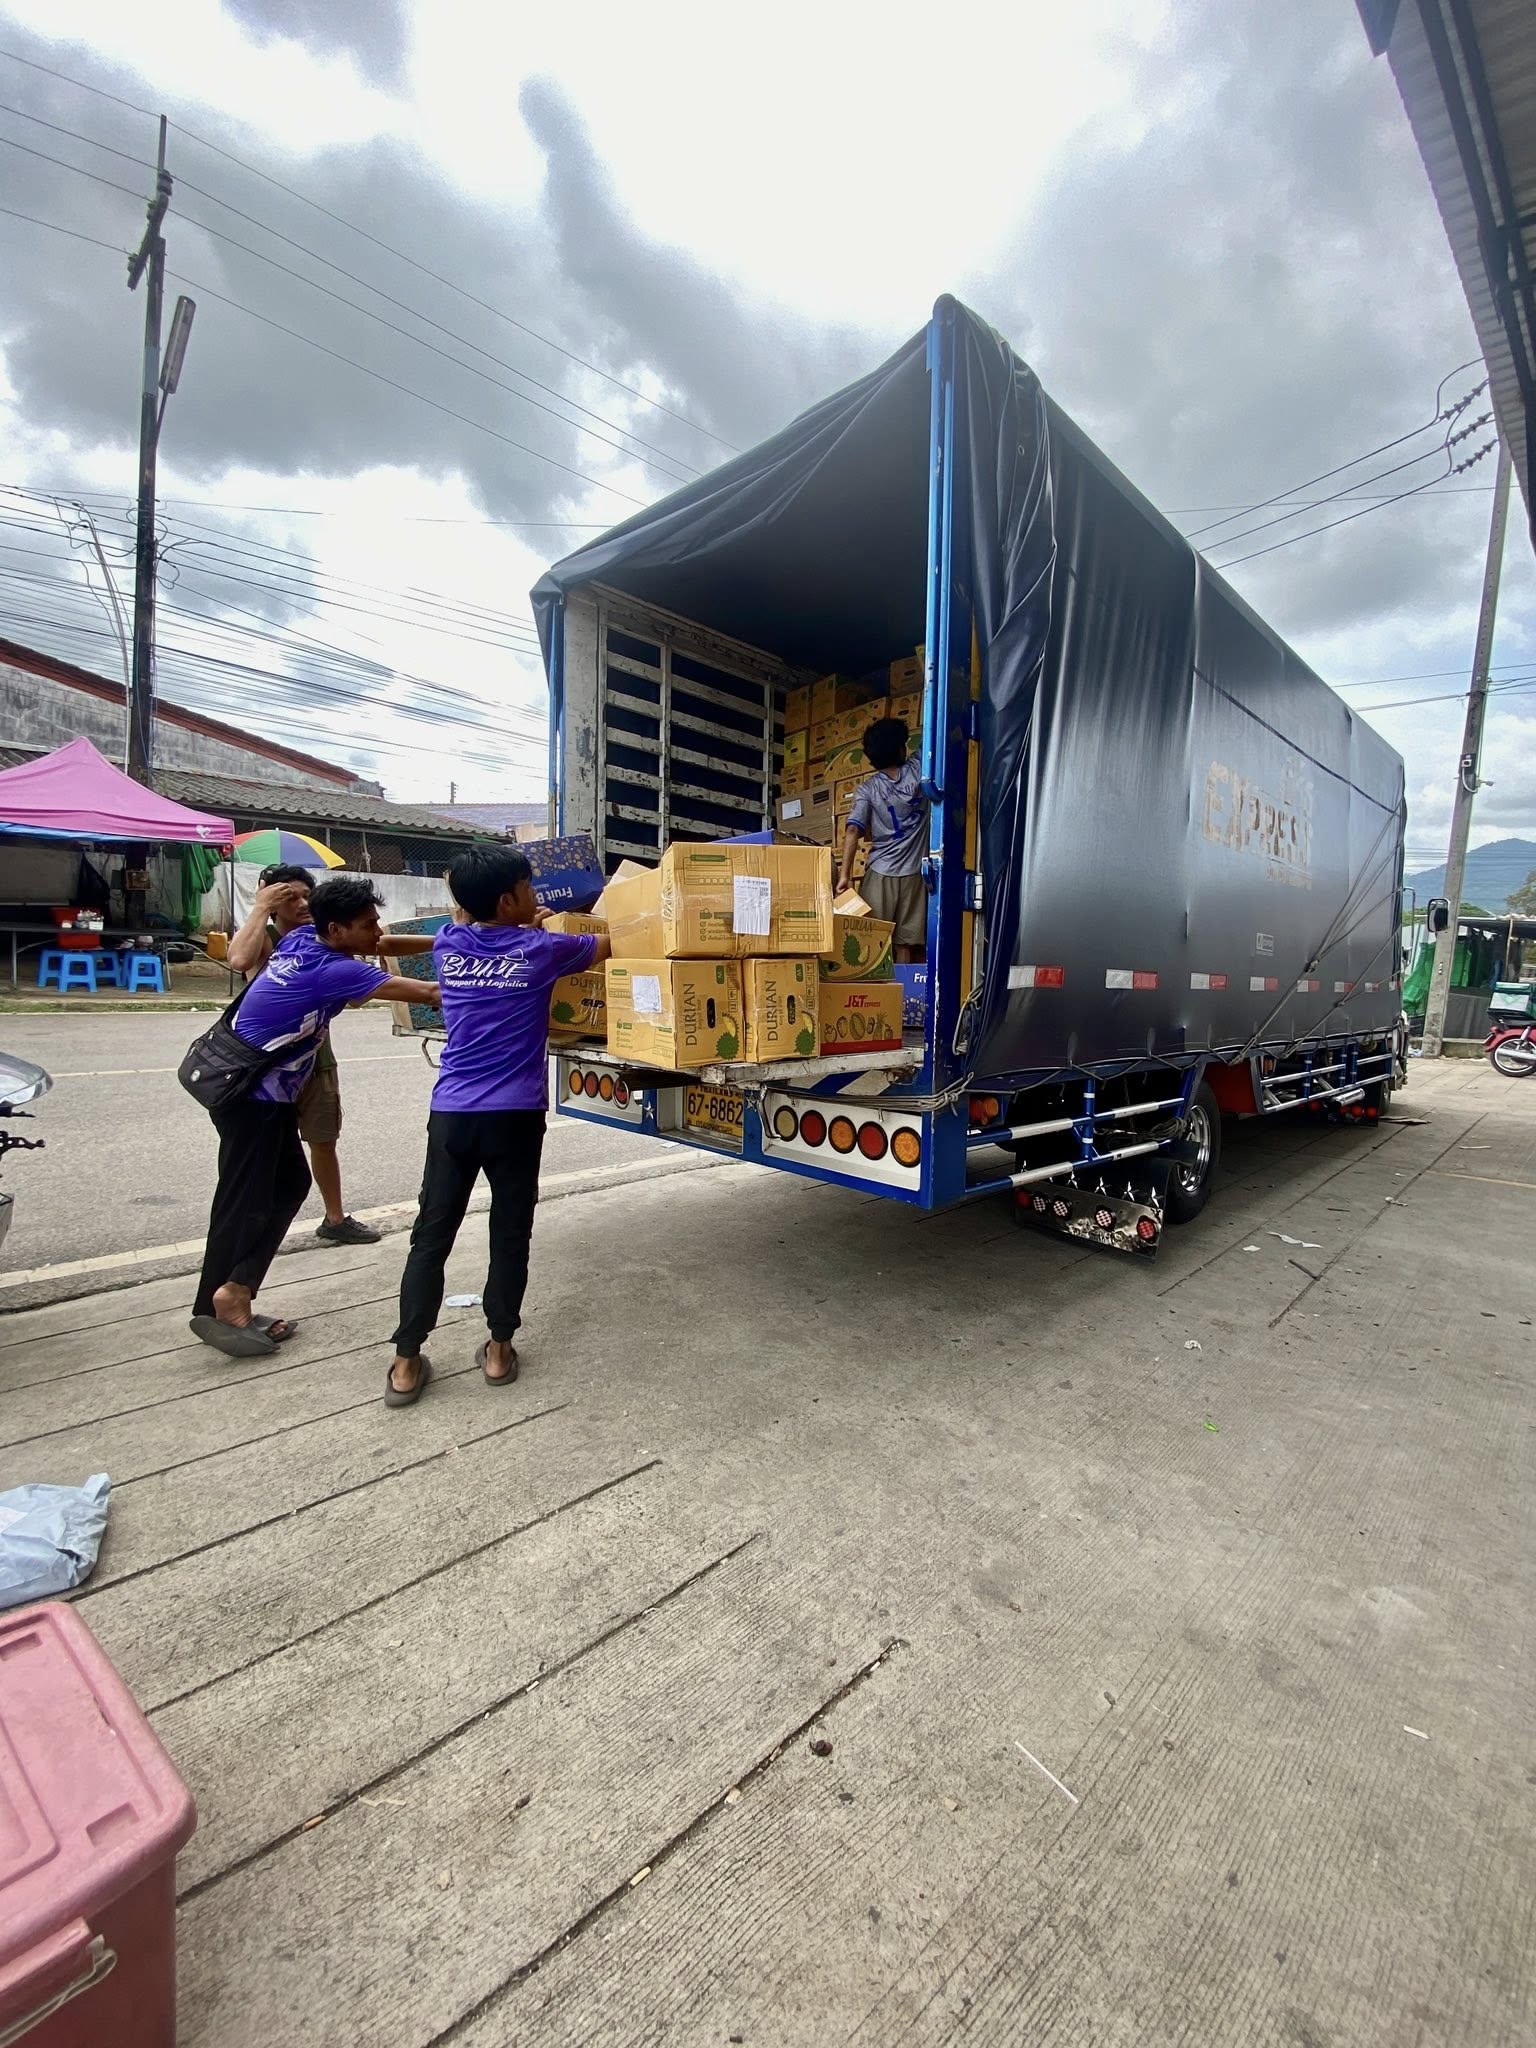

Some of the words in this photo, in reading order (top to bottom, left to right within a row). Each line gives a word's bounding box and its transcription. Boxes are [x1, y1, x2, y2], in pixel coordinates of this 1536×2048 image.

[545, 886, 573, 901] Fruit
[580, 923, 609, 934] DURI
[445, 978, 476, 987] Support
[478, 979, 486, 987] &
[487, 979, 528, 988] Logistics
[844, 995, 868, 1008] J&T
[683, 983, 697, 1046] DURIAN
[765, 981, 778, 1041] DURIAN
